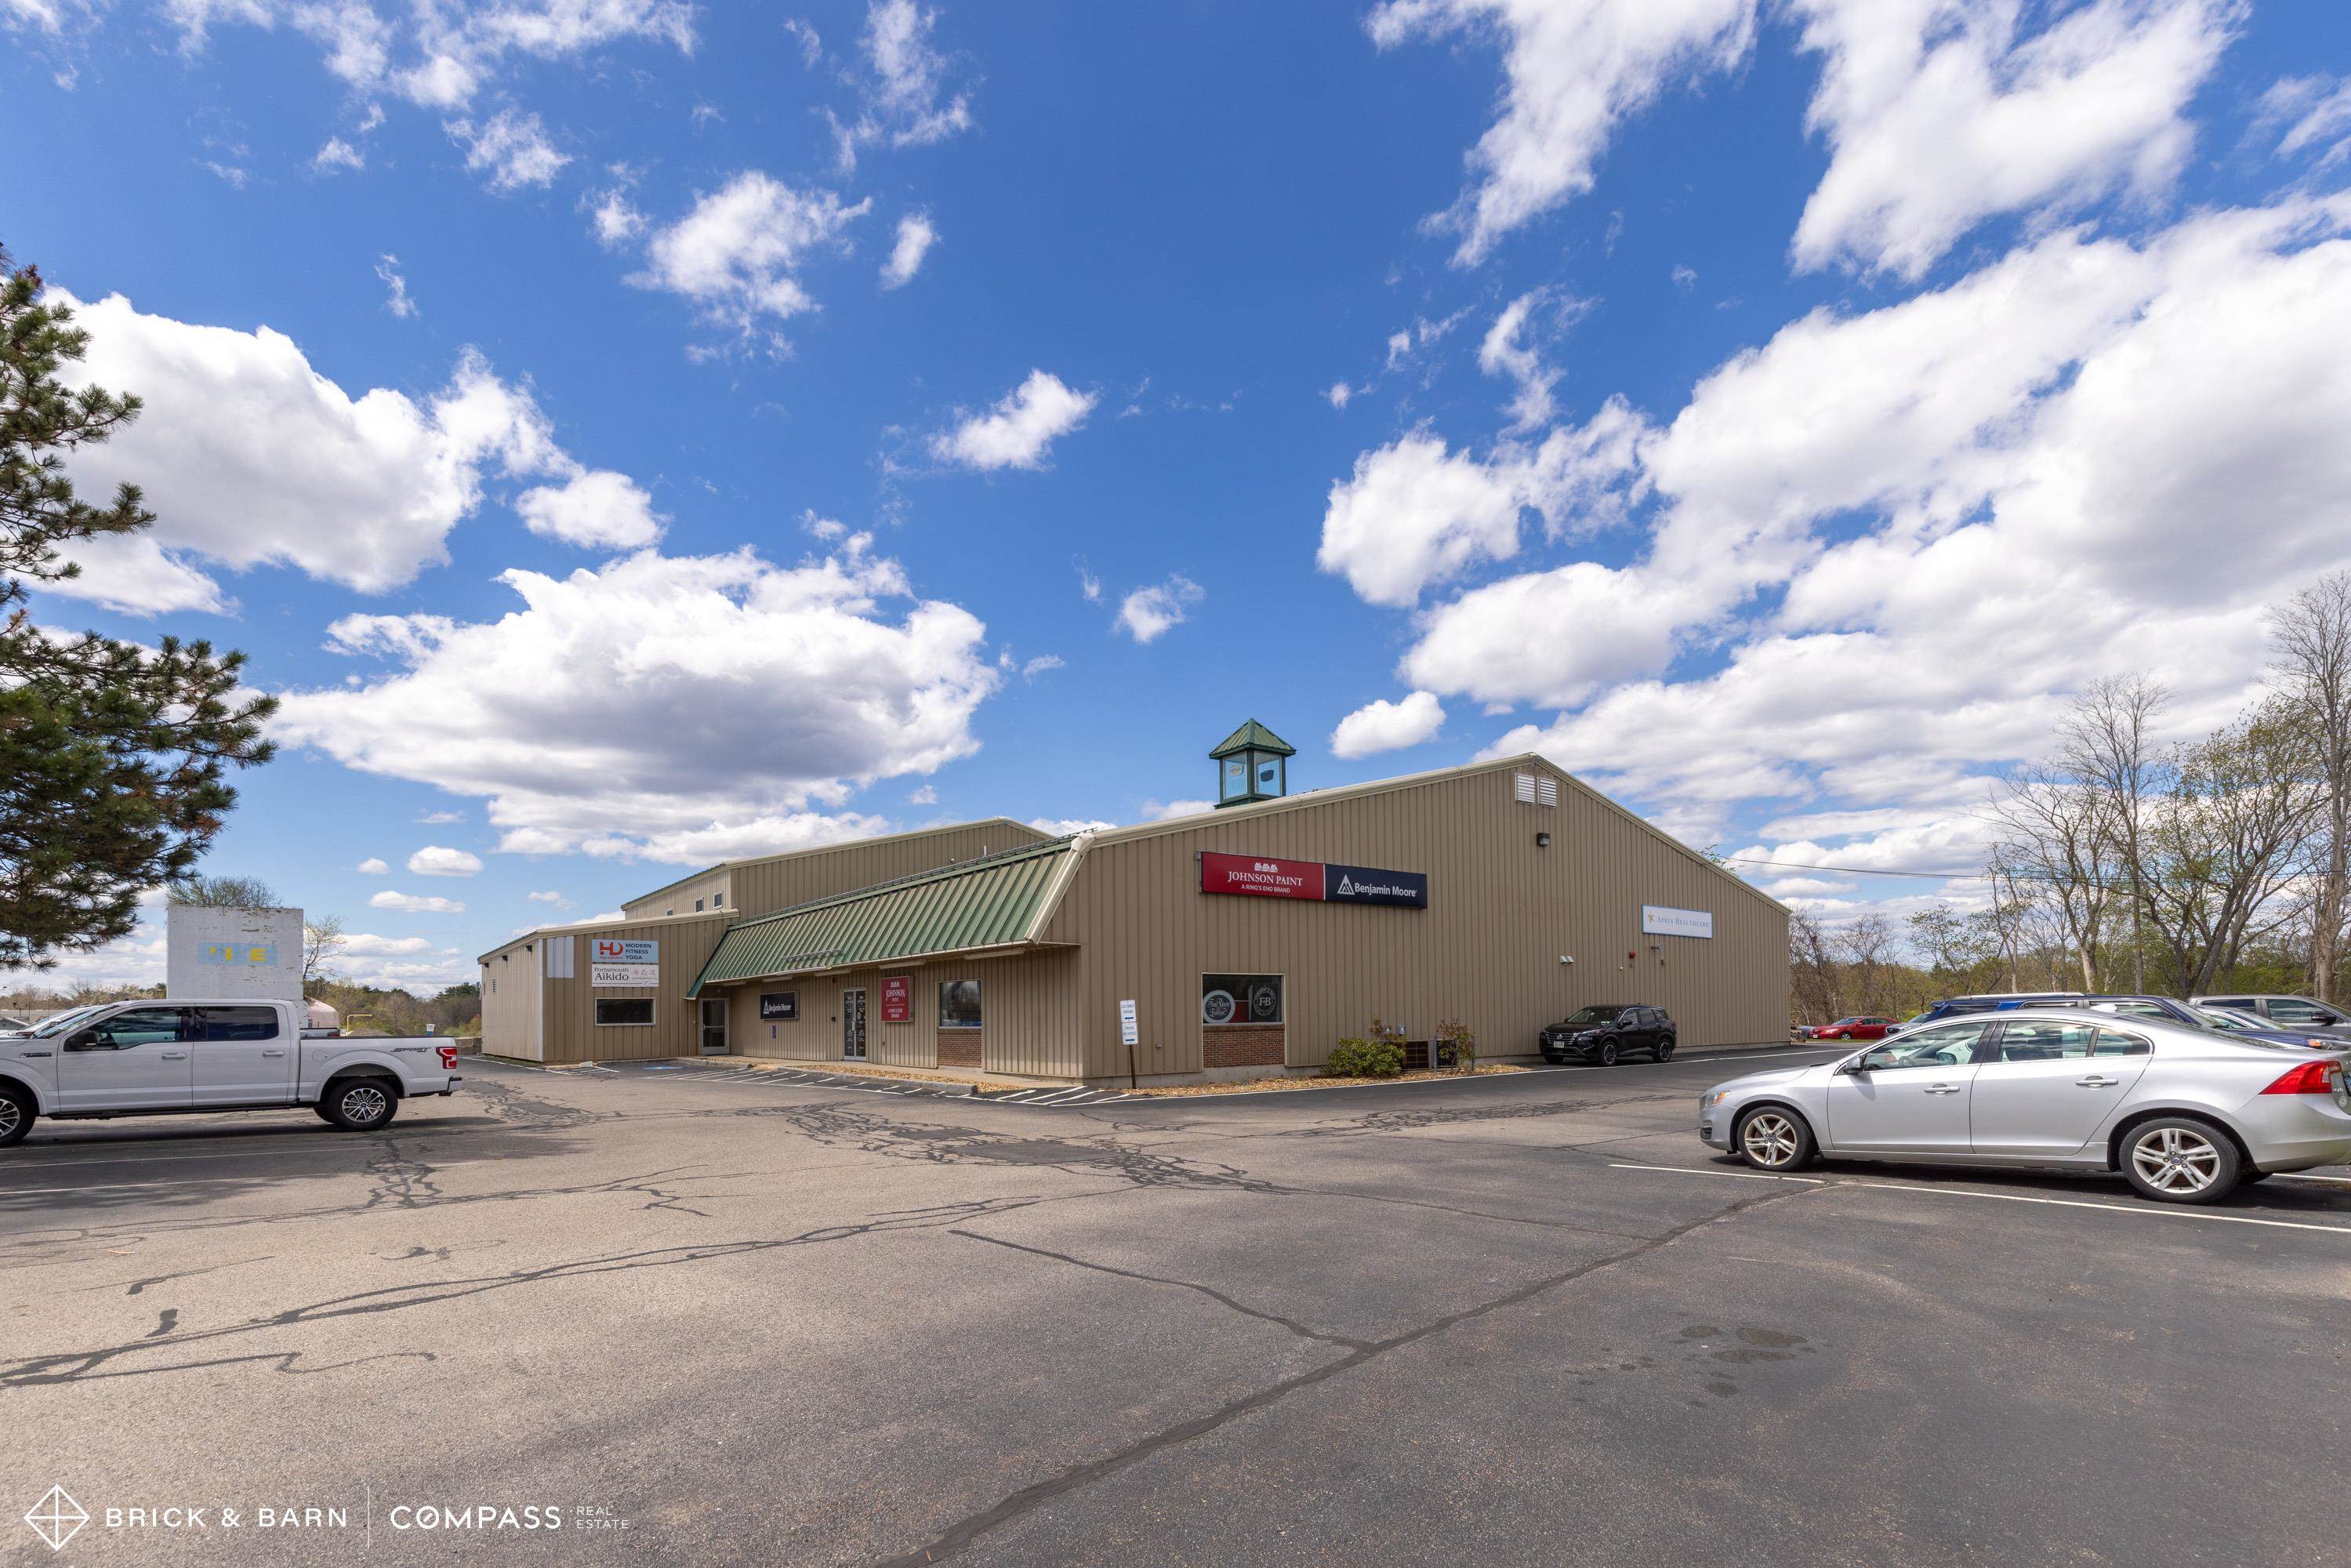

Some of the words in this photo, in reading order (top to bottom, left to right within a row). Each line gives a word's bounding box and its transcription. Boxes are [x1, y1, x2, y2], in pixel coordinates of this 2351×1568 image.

[1228, 871, 1274, 884] JOHNSON
[1276, 876, 1303, 886] PAINT
[1355, 883, 1390, 895] Benjamin
[1391, 886, 1416, 897] Moore
[595, 972, 629, 981] Aikido
